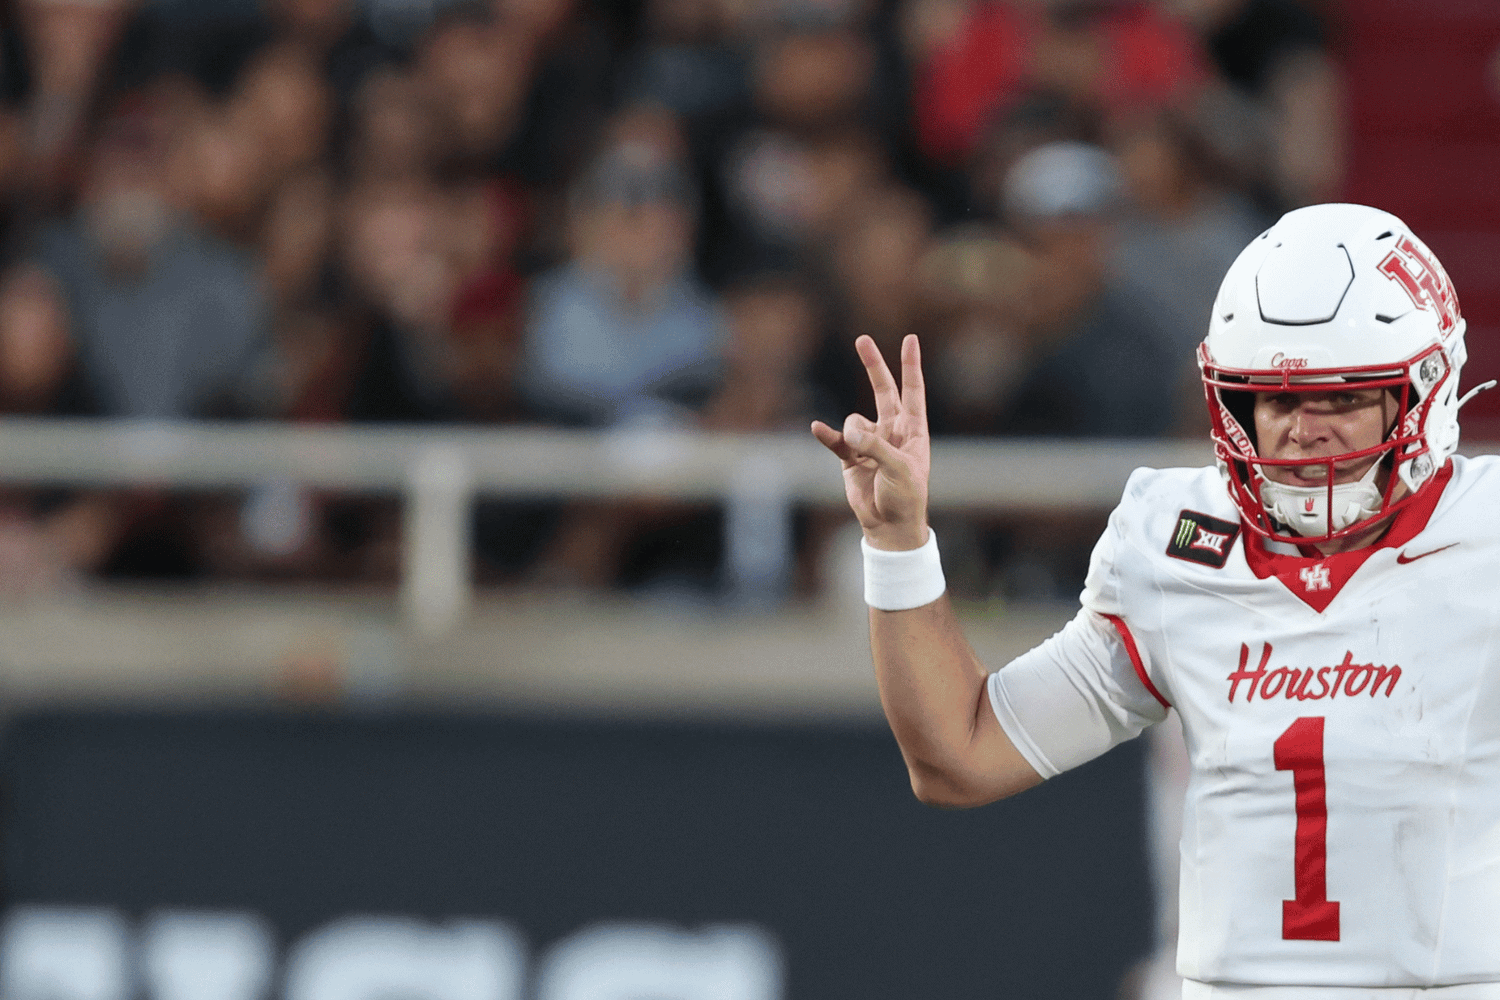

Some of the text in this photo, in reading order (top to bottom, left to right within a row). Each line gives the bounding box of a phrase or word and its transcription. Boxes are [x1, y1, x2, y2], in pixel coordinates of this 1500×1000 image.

[1299, 563, 1332, 592] UH
[1226, 641, 1402, 702] Houston
[1273, 716, 1341, 942] 1
